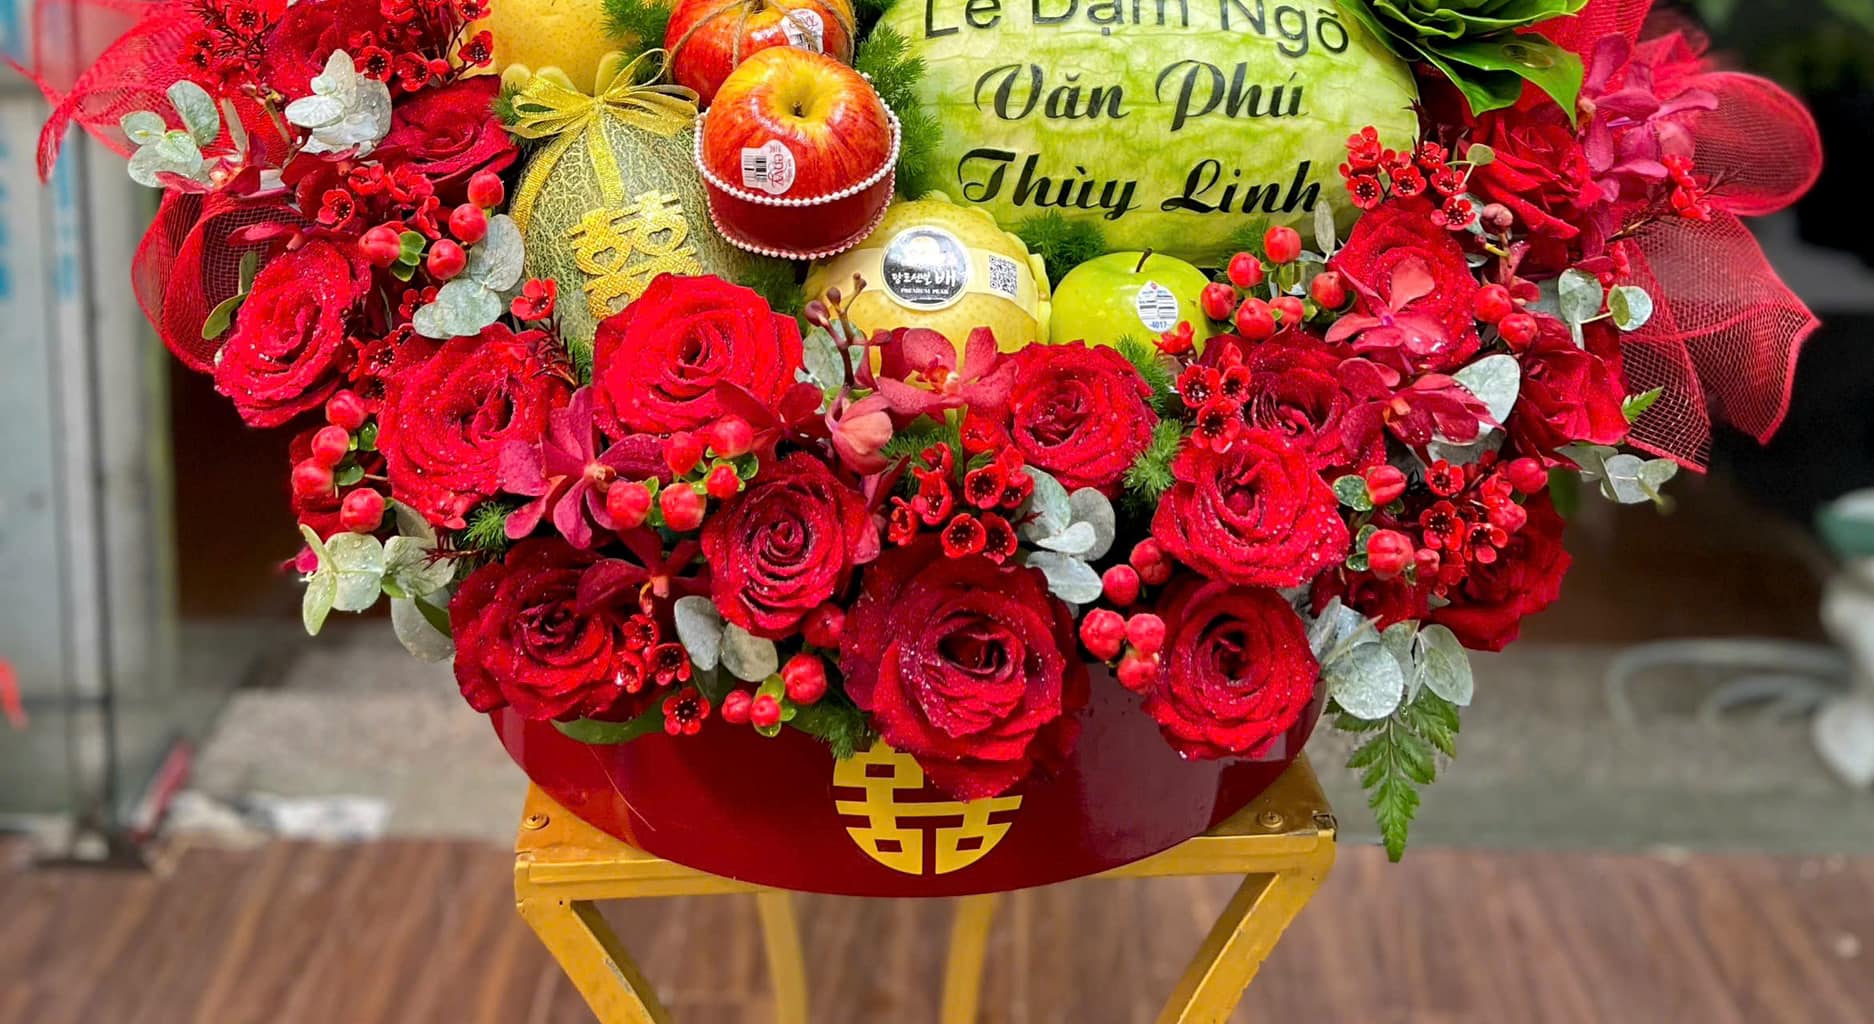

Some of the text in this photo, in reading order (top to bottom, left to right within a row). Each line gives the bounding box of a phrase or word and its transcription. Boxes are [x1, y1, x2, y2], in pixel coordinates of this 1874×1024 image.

[972, 59, 1310, 133] Văn Phú
[768, 153, 785, 189] envy
[957, 148, 1322, 221] Thùy Linh
